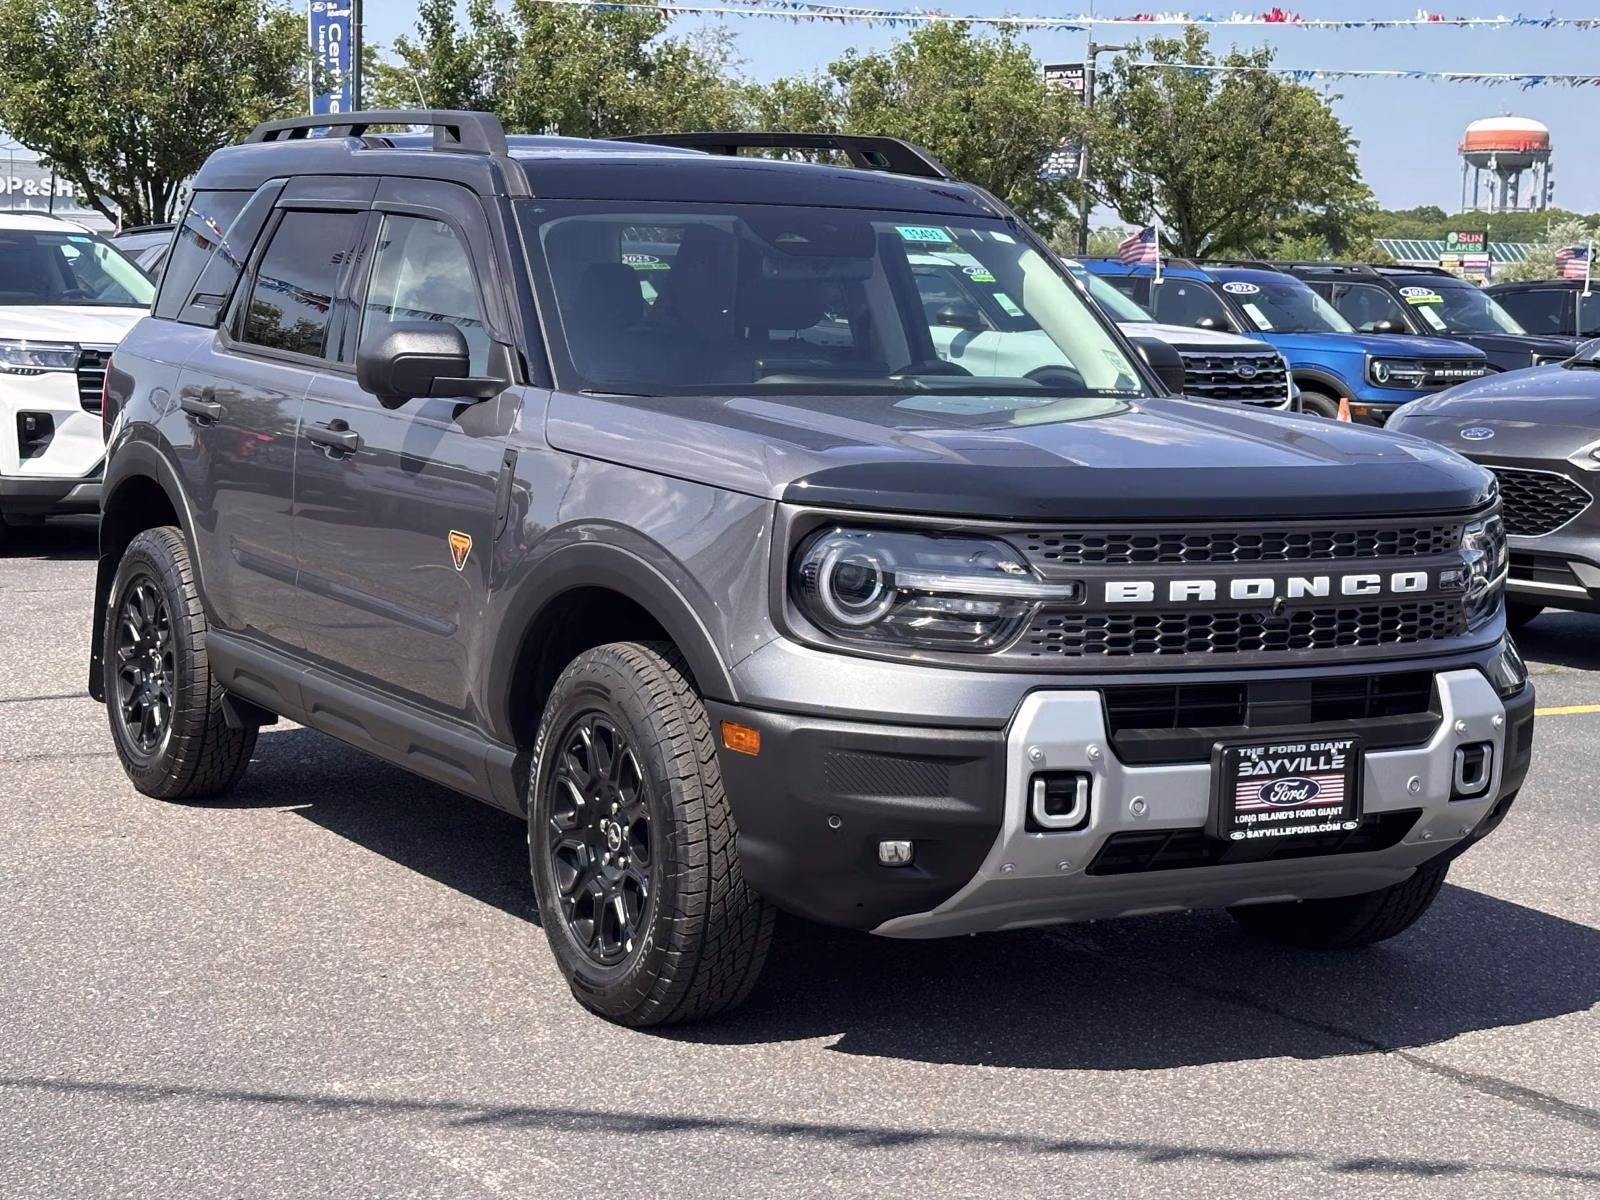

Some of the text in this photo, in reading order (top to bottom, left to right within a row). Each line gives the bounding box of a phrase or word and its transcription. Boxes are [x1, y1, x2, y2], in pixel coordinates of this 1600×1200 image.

[1458, 232, 1484, 242] SUN
[1446, 241, 1483, 251] LAKES
[1105, 571, 1429, 603] BRONCO
[1238, 741, 1353, 757] THE FORD GIANT
[1237, 754, 1346, 777] SAYVILLE
[1269, 781, 1310, 802] Ford
[1234, 806, 1343, 824] LONG ISLAND'S FORD GIANT
[1246, 822, 1341, 839] SAYVILLEFORD.COM
